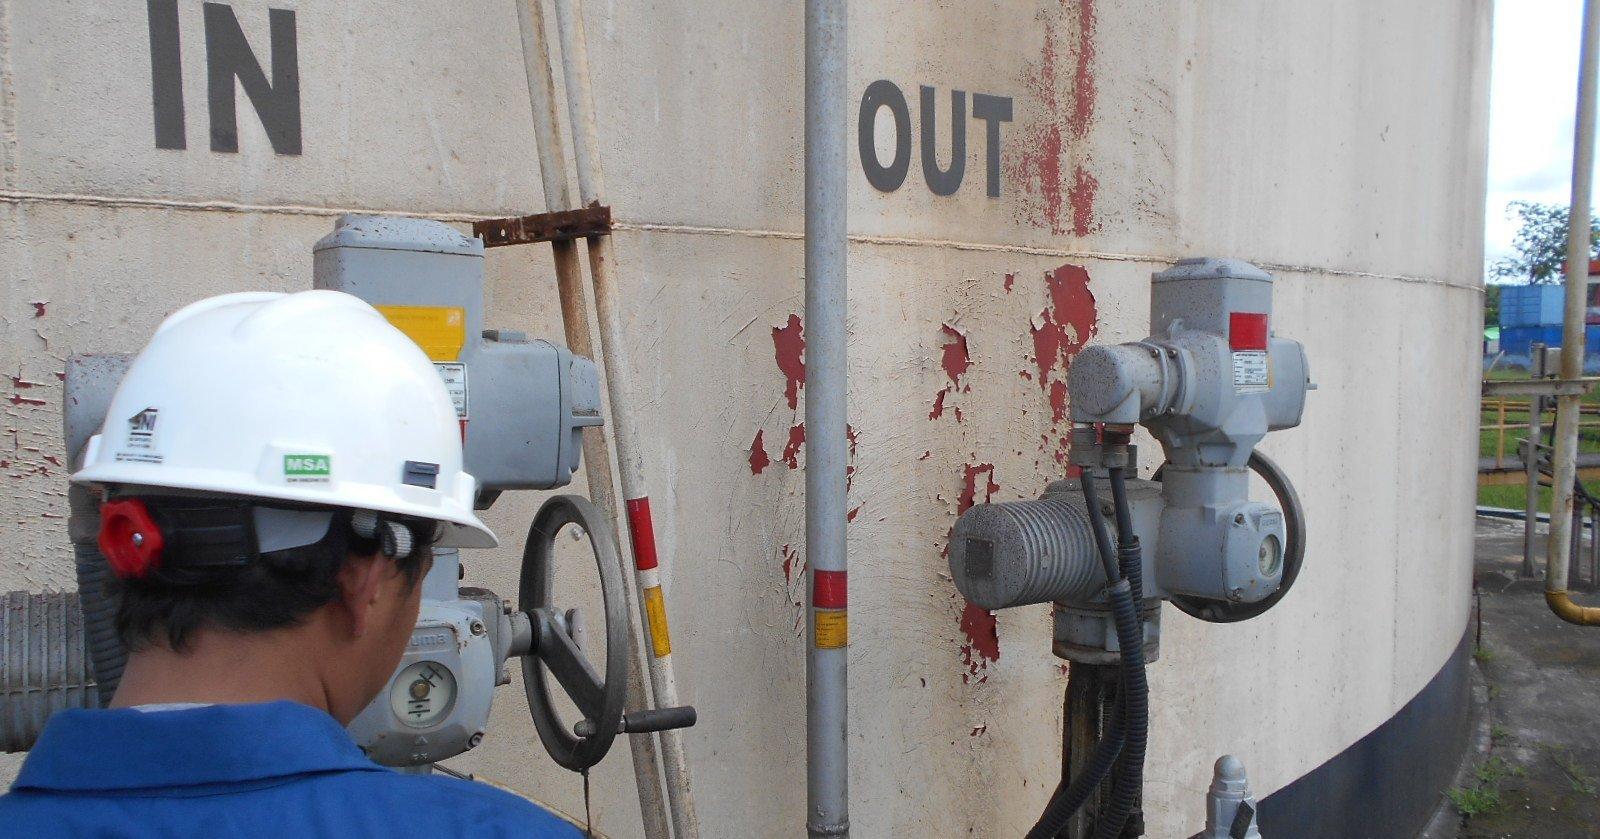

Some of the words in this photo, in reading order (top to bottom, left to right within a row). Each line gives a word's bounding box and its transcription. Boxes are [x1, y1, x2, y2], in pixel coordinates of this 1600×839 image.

[147, 0, 302, 155] IN
[858, 79, 1013, 197] OUT
[286, 458, 328, 471] MSA
